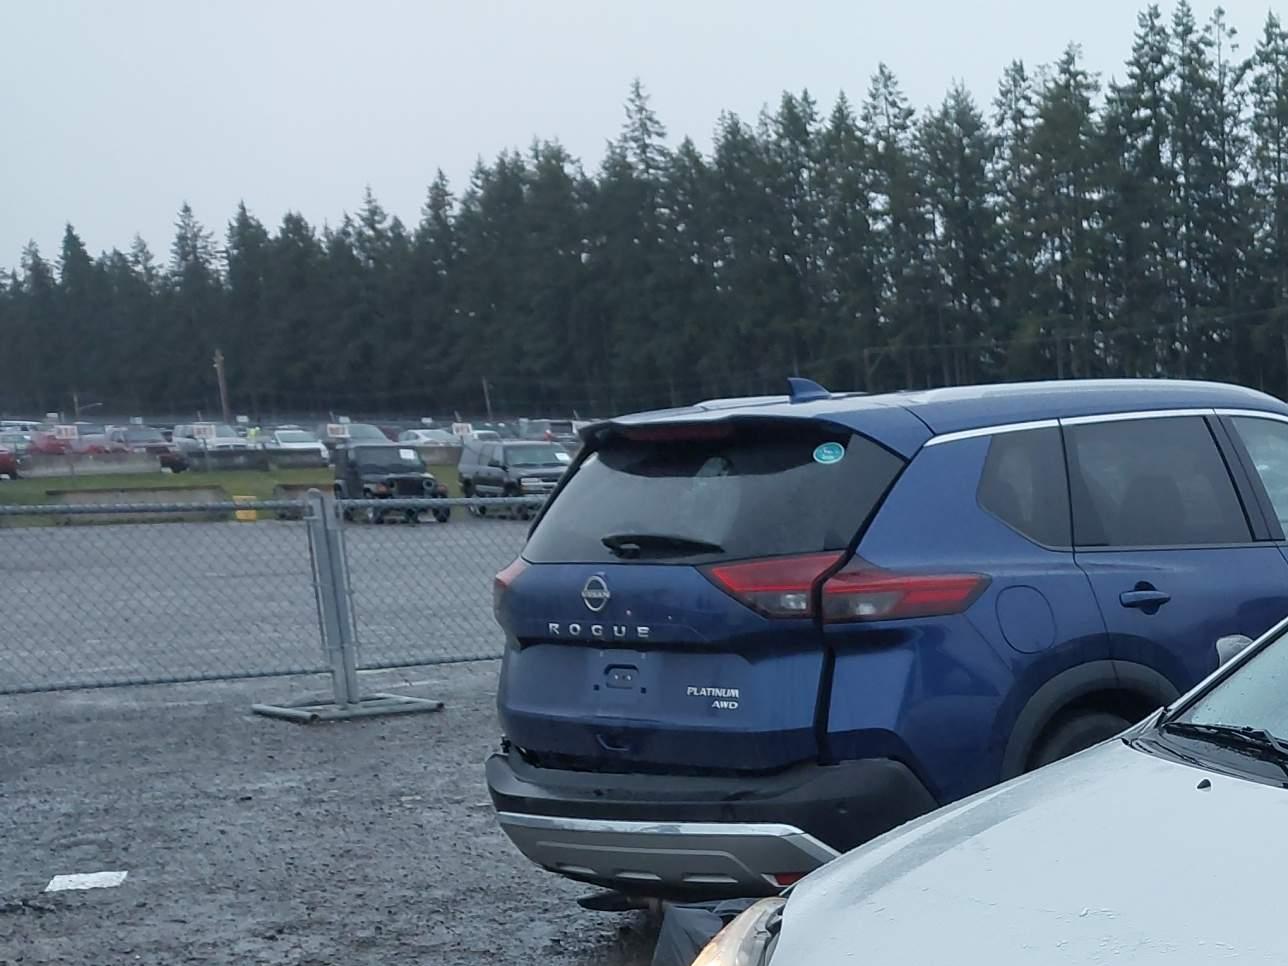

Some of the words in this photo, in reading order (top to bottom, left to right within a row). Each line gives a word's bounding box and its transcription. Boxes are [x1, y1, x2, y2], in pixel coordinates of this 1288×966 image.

[548, 622, 650, 638] ROGUE
[687, 686, 739, 698] PLATINUM
[711, 700, 738, 709] AWD
